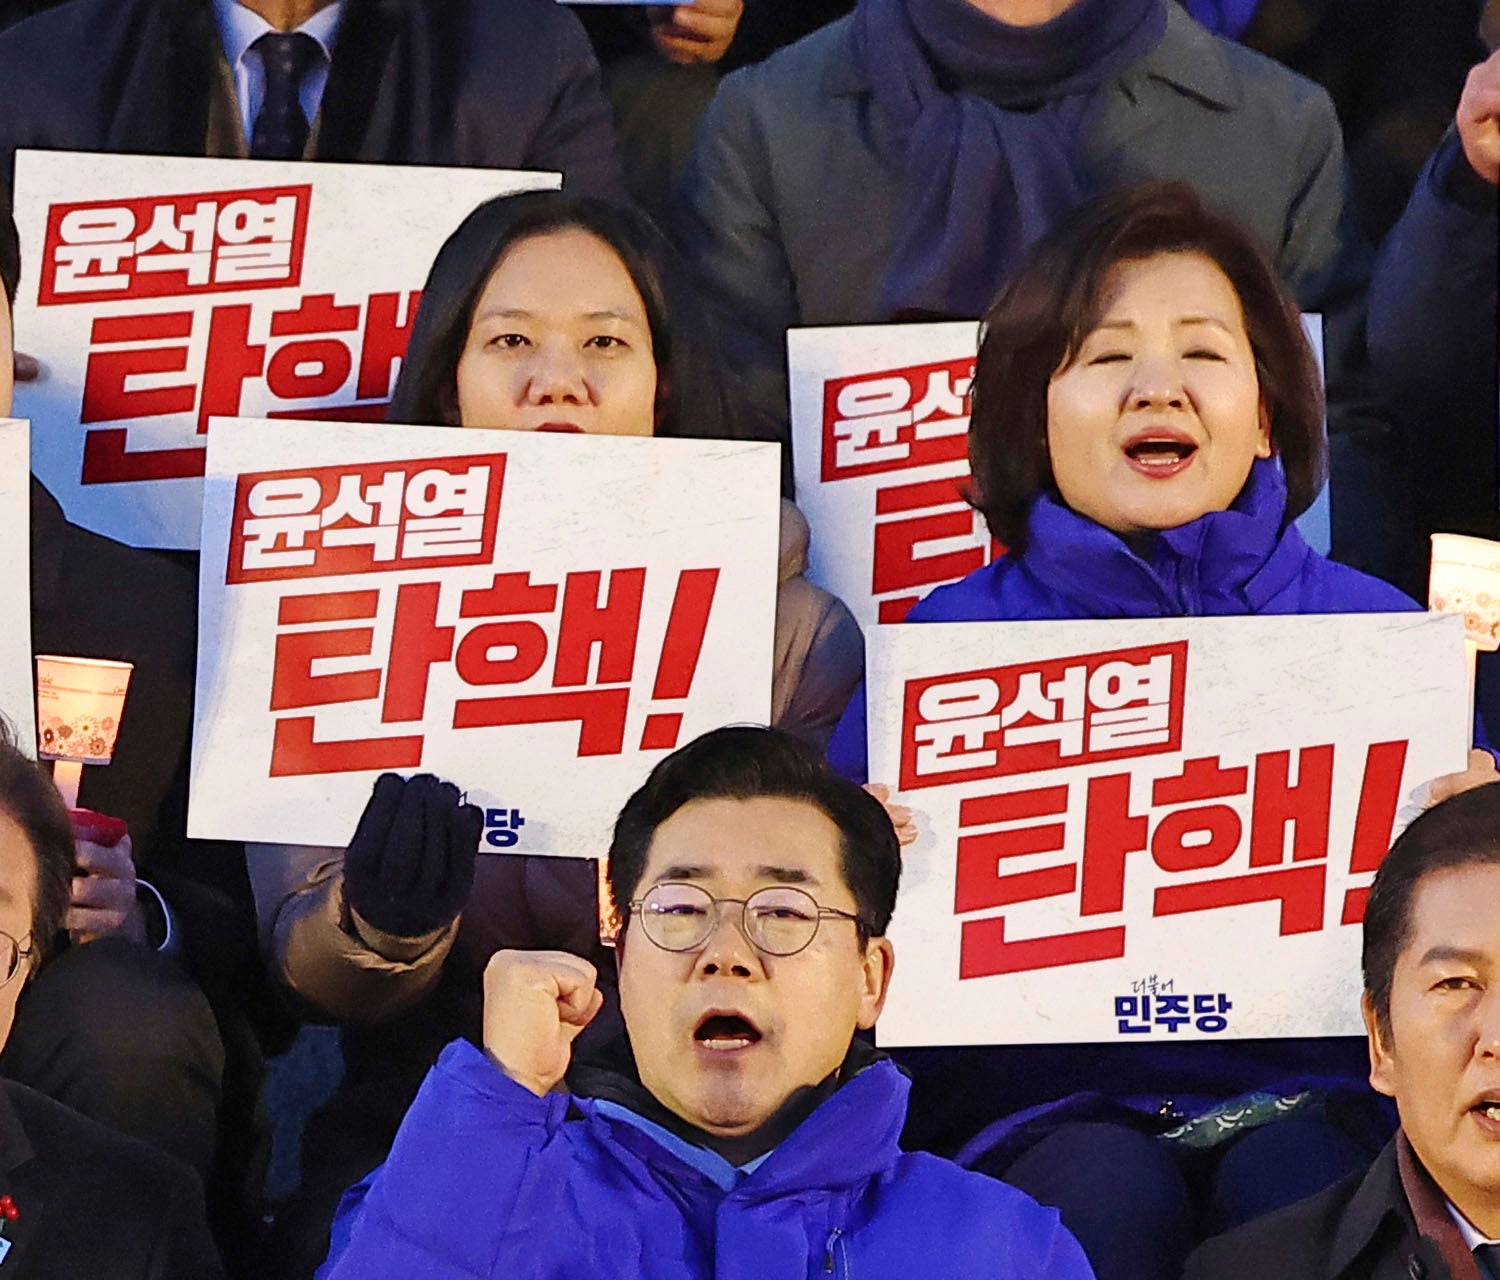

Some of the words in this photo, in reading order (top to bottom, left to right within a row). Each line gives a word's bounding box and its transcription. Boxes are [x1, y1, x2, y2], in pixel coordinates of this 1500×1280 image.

[53, 197, 295, 293] 윤석열
[242, 462, 490, 572] 윤석열
[270, 567, 720, 778] 탄핵!
[912, 657, 1171, 775] 윤석열
[955, 739, 1408, 981] 탄핵!
[1114, 994, 1231, 1033] 민주당
[1130, 975, 1175, 996] 더불어
